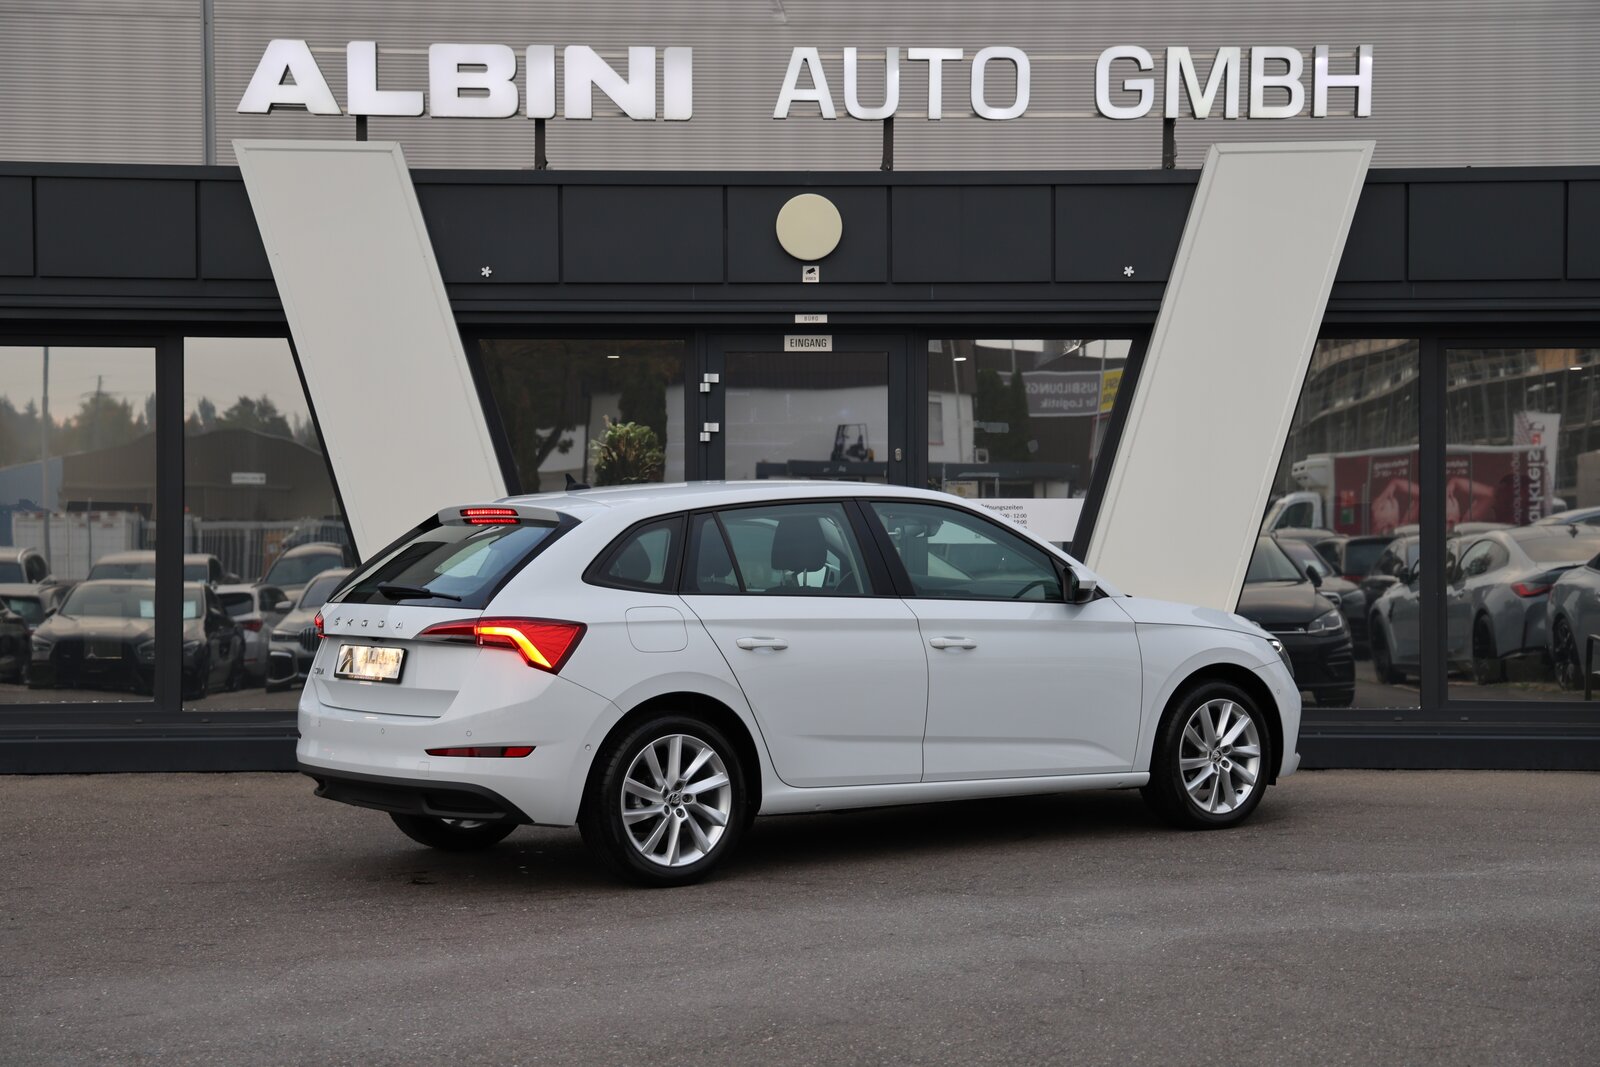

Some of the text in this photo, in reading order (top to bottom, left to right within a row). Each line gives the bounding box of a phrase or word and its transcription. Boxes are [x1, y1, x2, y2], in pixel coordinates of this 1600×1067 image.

[237, 38, 1374, 121] ALBINI AUTO GMBH
[790, 338, 827, 347] EINGANG
